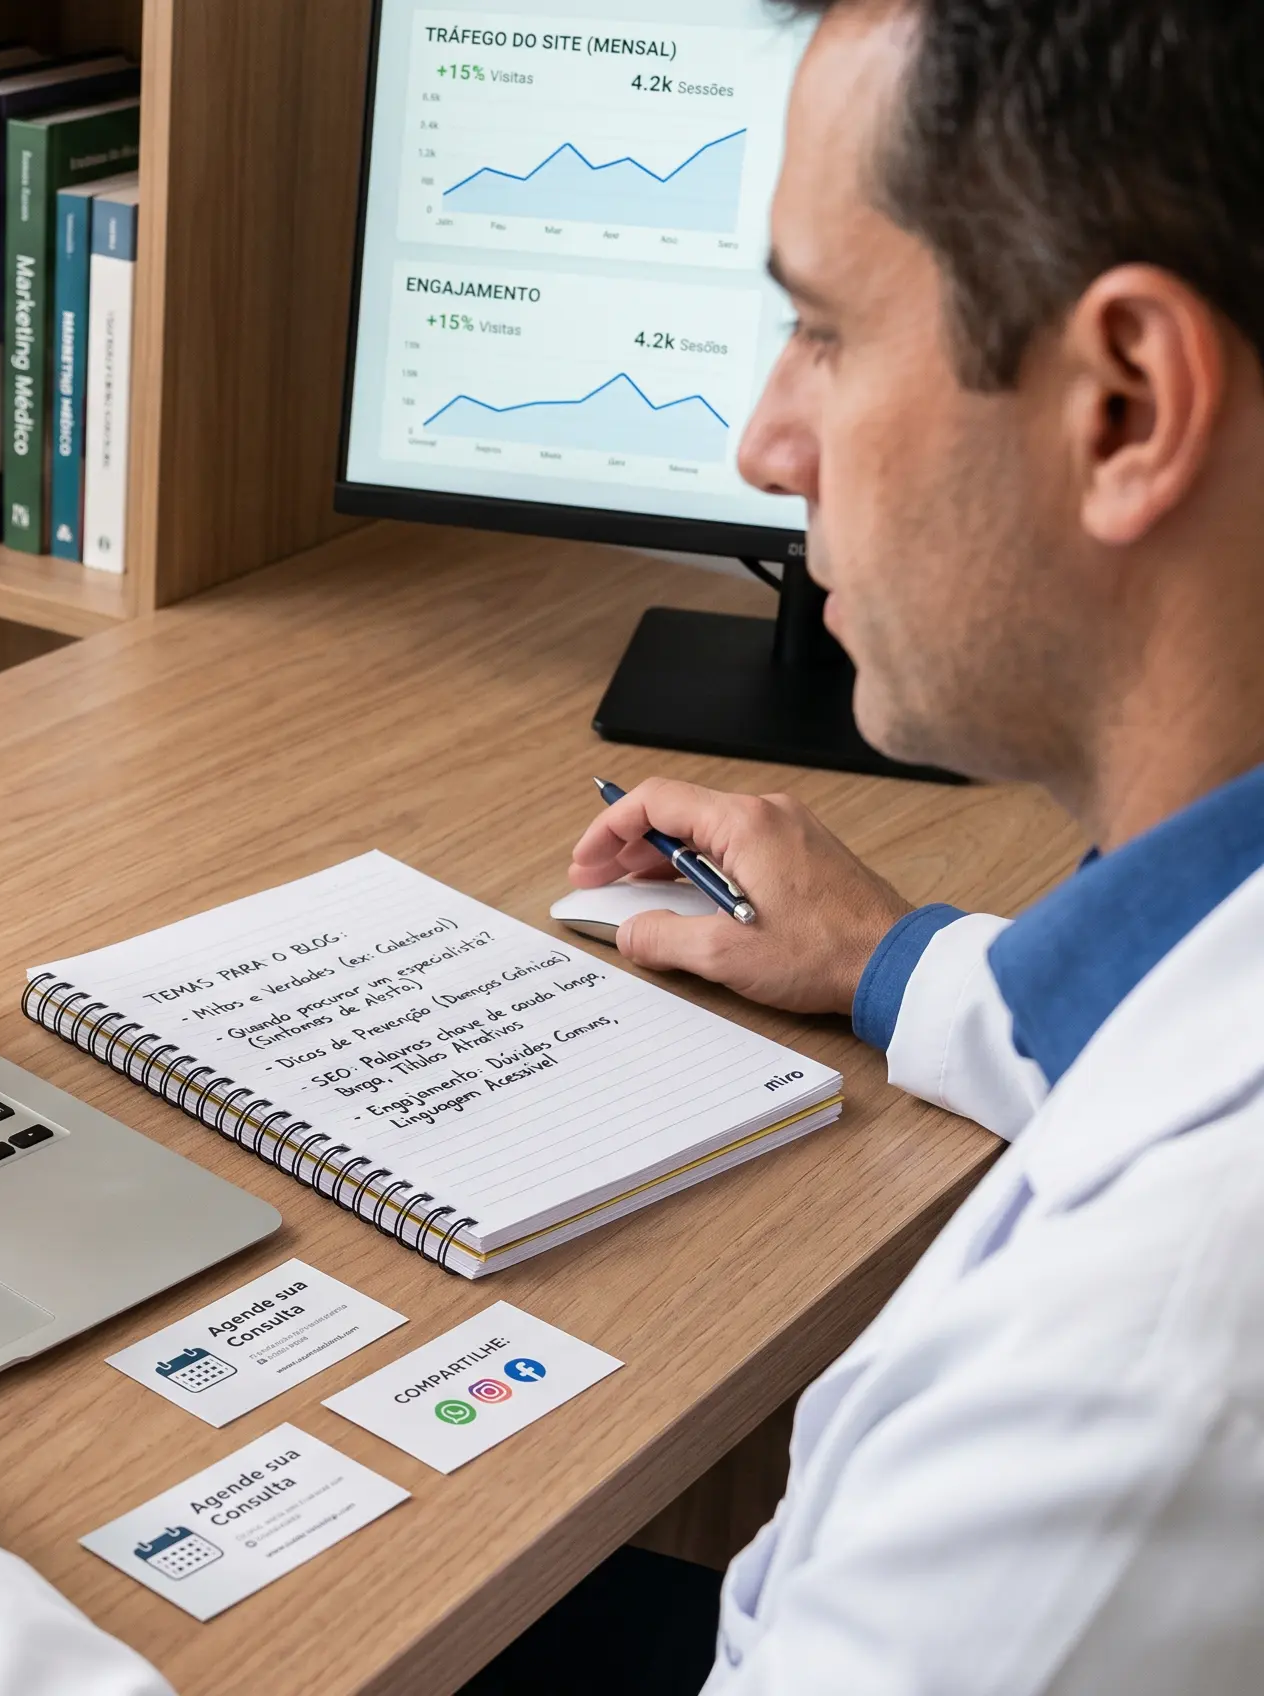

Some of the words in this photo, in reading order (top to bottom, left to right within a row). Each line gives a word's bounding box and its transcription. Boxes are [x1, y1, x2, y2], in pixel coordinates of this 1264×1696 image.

[426, 26, 507, 46] TRÁFEGO
[512, 32, 537, 48] DO
[542, 34, 582, 51] SITE
[587, 36, 676, 61] (MENSAL)
[437, 64, 485, 81] +15%
[490, 70, 533, 85] Visitas
[631, 74, 673, 93] 4.2k
[678, 81, 734, 97] Sessões
[10, 254, 37, 369] Marketing
[406, 277, 540, 302] ENGAJAMENTO
[426, 314, 474, 332] +15%
[479, 321, 521, 336] Visitas
[633, 331, 675, 350] 4.2k
[12, 373, 34, 456] Médico
[142, 978, 214, 1004] TEMAS
[216, 960, 268, 981] PARA
[272, 952, 287, 961] O
[289, 932, 347, 955] BLOG:
[191, 1001, 244, 1020] Mitos
[249, 993, 262, 1003] e
[261, 967, 336, 994] Verdades
[338, 953, 374, 968] (ex:
[296, 986, 359, 1018] procurar
[368, 977, 392, 988] um
[339, 1005, 360, 1016] de
[311, 1067, 358, 1087] SEO:
[437, 1020, 485, 1041] chave
[486, 1009, 507, 1021] de
[553, 973, 605, 992] longa,
[330, 1038, 352, 1050] de
[351, 1008, 431, 1040] Prevenção
[451, 1021, 524, 1054] Atrativos
[366, 1069, 483, 1116] Engajamento:
[485, 1042, 552, 1069] Dúvidas
[763, 1070, 804, 1091] miro
[208, 1300, 275, 1337] Agende
[275, 1282, 308, 1301] sua
[227, 1306, 305, 1347] Consulta
[394, 1338, 510, 1404] COMPARTILHE:
[190, 1471, 264, 1515] Agende
[265, 1450, 301, 1472] sua
[211, 1478, 296, 1526] Consulta
